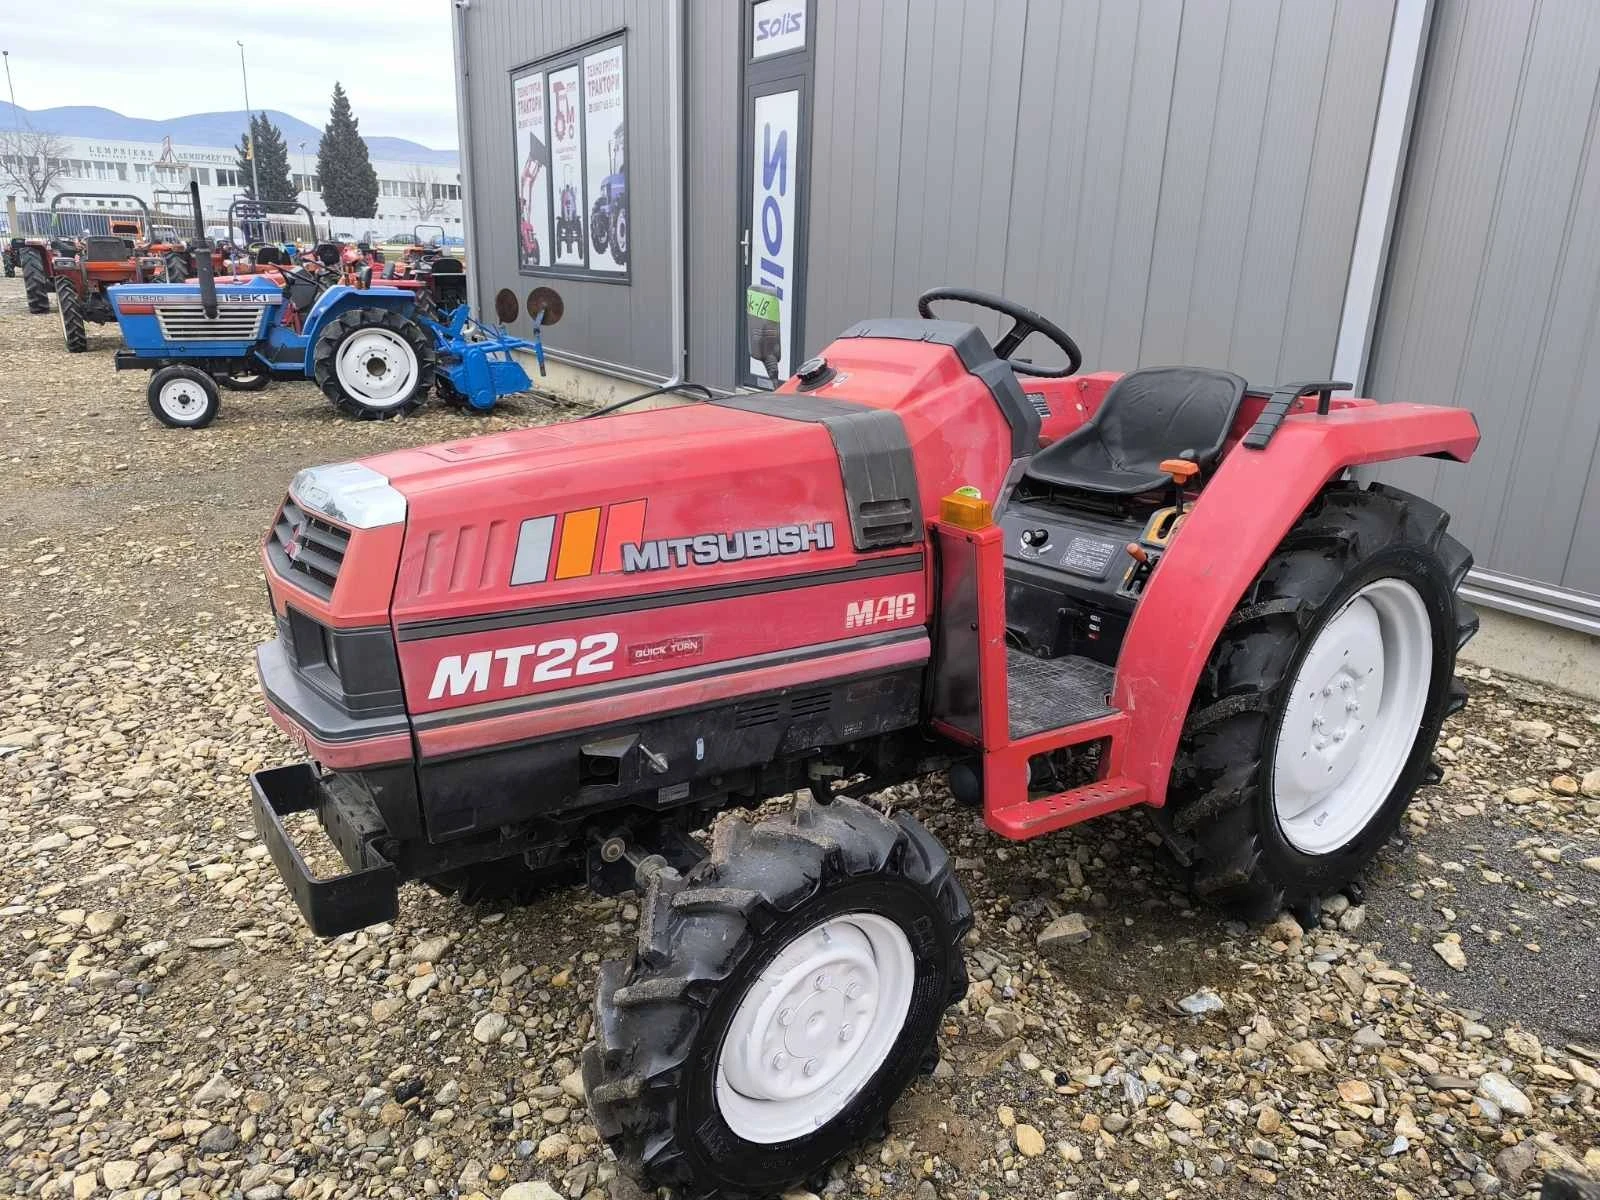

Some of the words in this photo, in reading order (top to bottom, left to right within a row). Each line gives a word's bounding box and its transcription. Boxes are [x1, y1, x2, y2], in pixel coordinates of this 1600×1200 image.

[588, 73, 619, 97] ТРАКТОРИ
[224, 294, 267, 302] ISEKI
[622, 521, 835, 573] MITSUBISHI
[845, 593, 916, 629] MAC
[635, 645, 667, 658] QUICK
[670, 640, 698, 652] TURN
[427, 632, 619, 700] MT22
